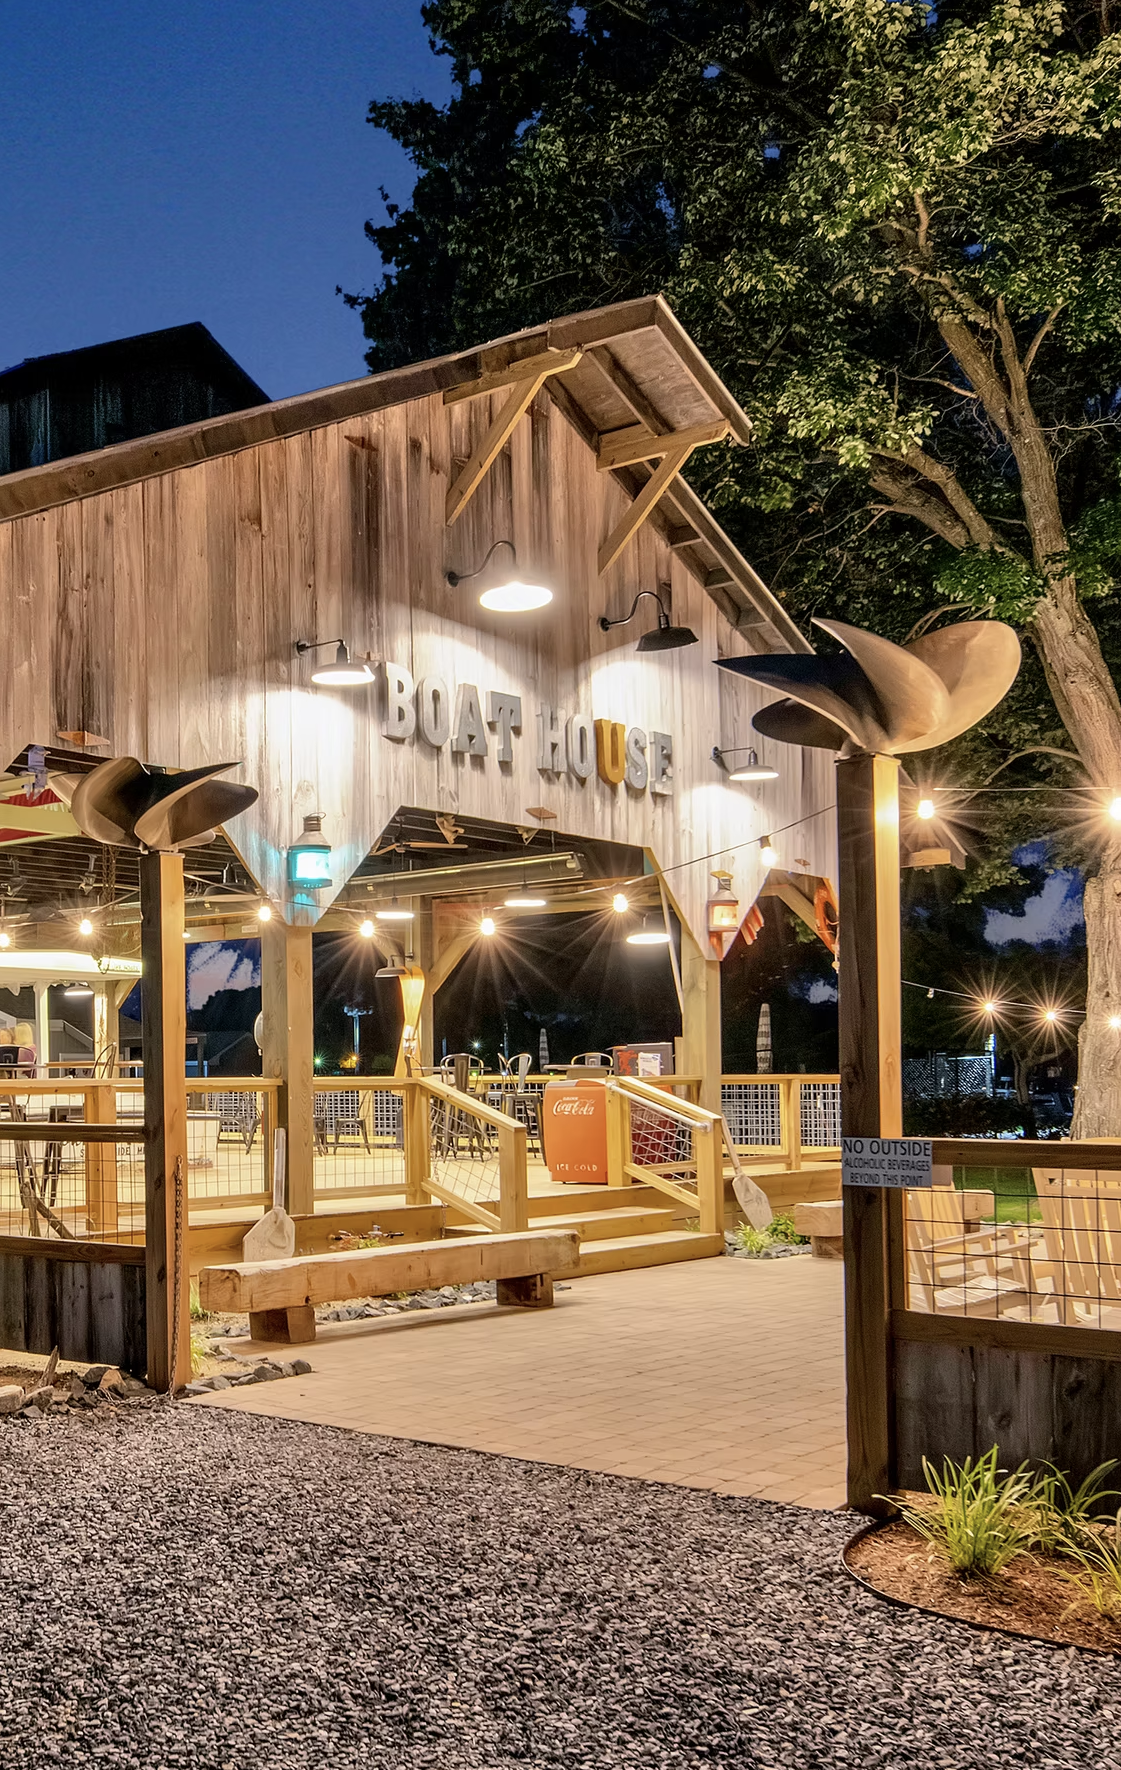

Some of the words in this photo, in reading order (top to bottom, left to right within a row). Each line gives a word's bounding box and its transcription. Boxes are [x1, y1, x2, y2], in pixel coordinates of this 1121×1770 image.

[381, 661, 522, 763] BOAT
[536, 702, 673, 796] HOUSE
[843, 1139, 864, 1154] NO
[869, 1140, 931, 1157] OUTSIDE
[556, 1163, 569, 1171] ICE
[574, 1164, 598, 1172] COLD
[844, 1157, 886, 1170] ALCOHOLIC
[887, 1159, 930, 1172] BEVERAGES
[850, 1172, 880, 1184] BEYOND
[882, 1173, 898, 1185] THIS
[900, 1174, 923, 1186] POINT
